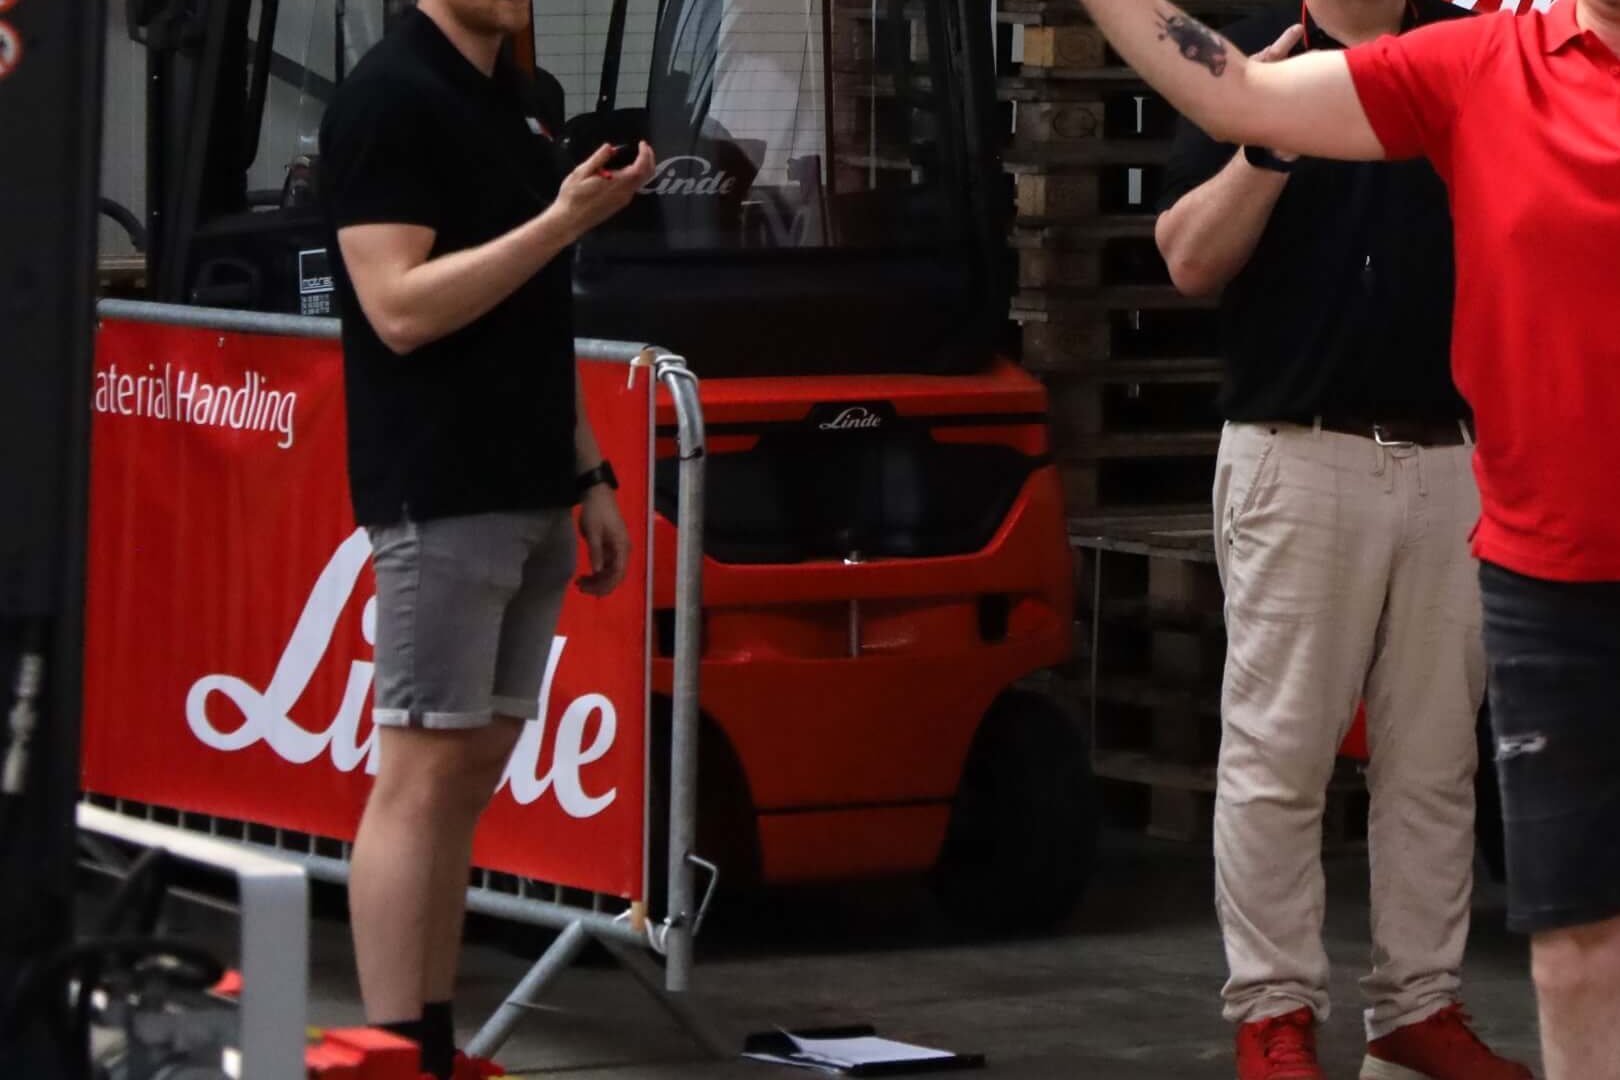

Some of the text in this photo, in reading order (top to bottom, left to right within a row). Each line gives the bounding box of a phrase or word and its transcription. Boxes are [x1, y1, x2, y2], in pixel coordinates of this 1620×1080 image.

[639, 155, 737, 195] Linde
[94, 362, 297, 449] aterial Handling
[818, 406, 881, 430] Linde
